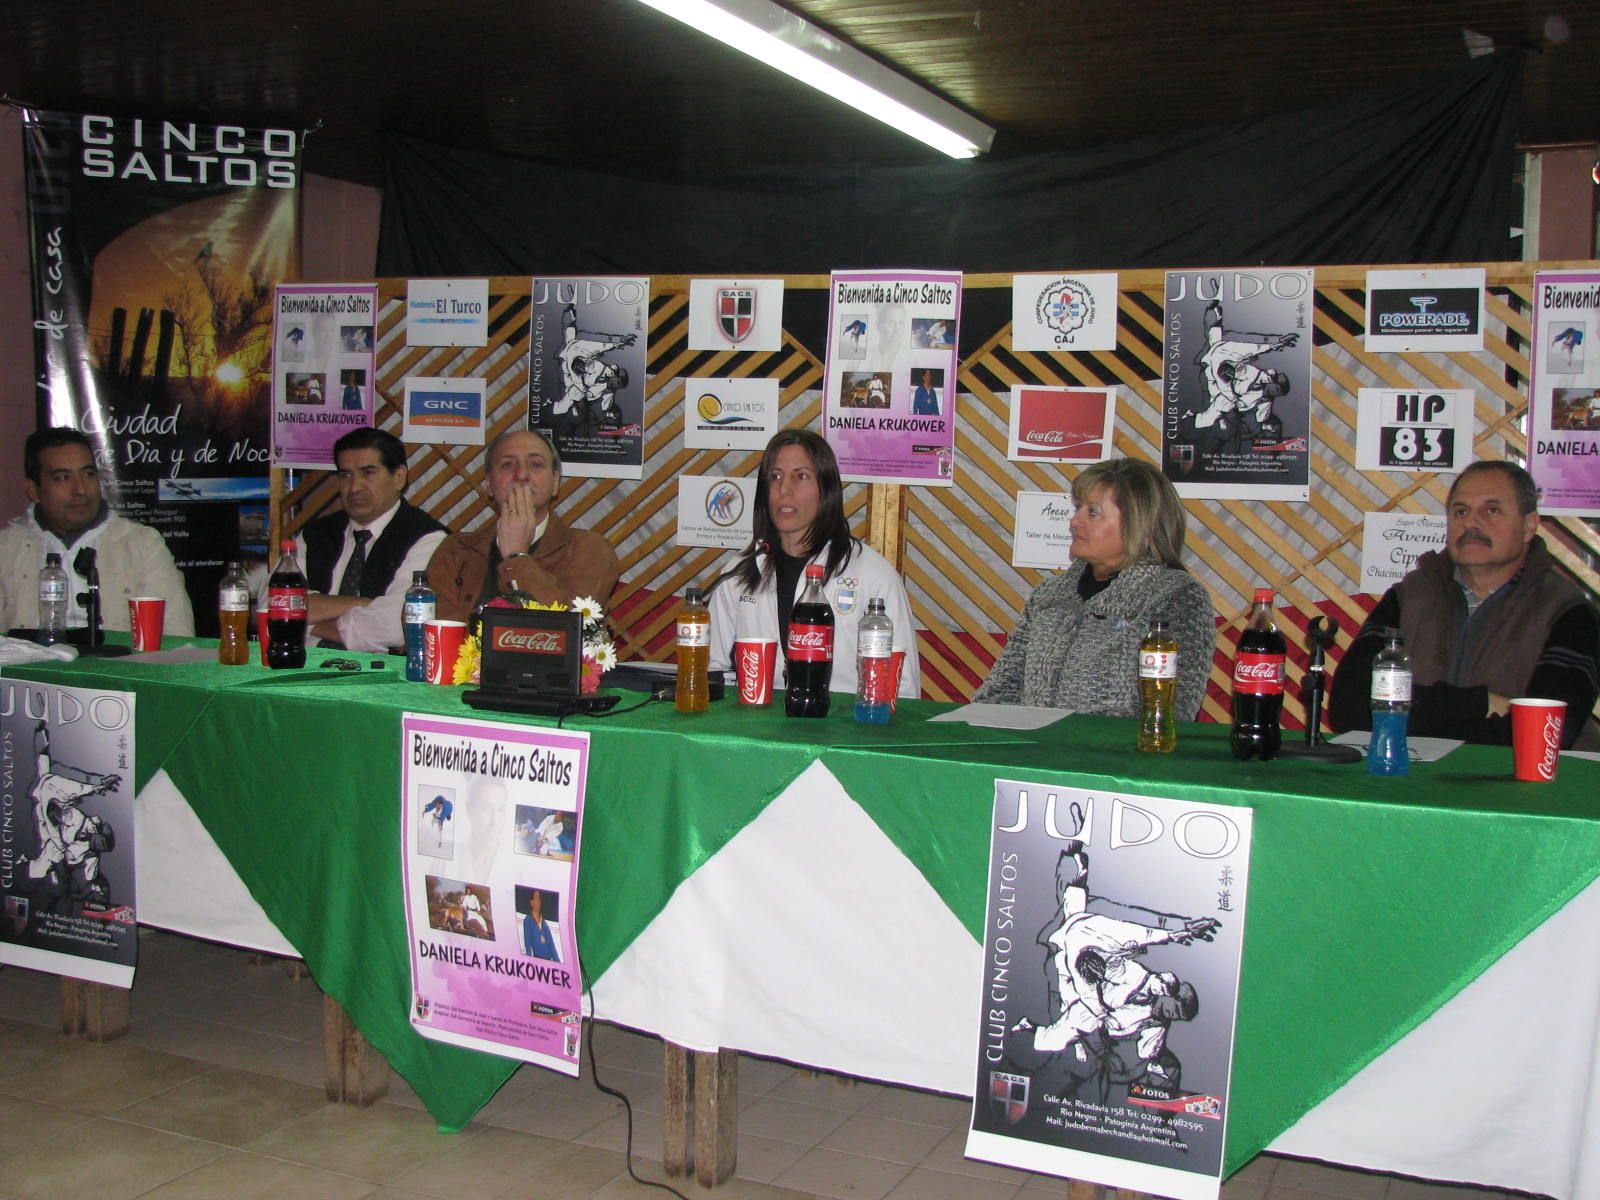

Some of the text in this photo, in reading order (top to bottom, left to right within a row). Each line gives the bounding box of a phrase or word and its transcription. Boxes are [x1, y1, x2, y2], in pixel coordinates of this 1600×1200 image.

[82, 114, 296, 157] CINCO
[82, 149, 296, 189] SALTOS
[46, 227, 63, 295] casa
[535, 280, 645, 305] JUDO
[838, 283, 952, 305] Bienvenida a Cinco Saltos
[1168, 272, 1308, 302] JUDO
[1544, 285, 1600, 309] Bienvenid
[281, 295, 319, 313] Bienvenida
[326, 296, 346, 313] Cinco
[347, 297, 370, 313] Saltos
[436, 299, 447, 313] El
[451, 299, 482, 314] Turco
[1380, 313, 1465, 327] POWERADE
[1054, 335, 1075, 343] CAJ
[531, 313, 545, 424] CLUB CINCO SALTOS
[1167, 312, 1182, 440] CLUB CINCO SALTOS
[424, 400, 469, 411] GNC
[1396, 394, 1446, 422] HP
[278, 411, 368, 425] DANIELA KRUKOWER
[829, 417, 946, 433] DANIELA KRUKOWER
[1027, 430, 1064, 442] Coca-Cola
[1393, 429, 1443, 461] 83
[1537, 440, 1598, 456] DANIELA
[125, 439, 163, 466] Dia
[172, 447, 185, 479] y
[194, 439, 219, 464] de
[228, 438, 274, 464] Noc
[1053, 533, 1072, 541] Mecan
[1383, 528, 1447, 544] Avenid
[498, 630, 561, 651] Coca-Cola
[787, 631, 825, 647] Coca-Cola
[742, 648, 759, 703] Coca-Cola
[1234, 660, 1277, 678] Coca-Cola
[0, 684, 130, 731] JUDO
[1537, 712, 1562, 780] Coca-Cola
[413, 733, 572, 786] Bienvenida a Cinco Saltos
[2, 731, 13, 888] CLUB CINCO SALTOS
[997, 790, 1240, 859] JUDO
[419, 940, 572, 989] DANIELA KRUKOWER
[986, 852, 1018, 1063] CLUB CINCO SALTOS
[994, 1073, 1025, 1084] CACS
[1043, 1094, 1060, 1104] Calle
[1062, 1098, 1072, 1107] Av.
[1075, 1100, 1109, 1114] Rivadavia
[1110, 1107, 1124, 1117] 158
[1142, 1088, 1170, 1100] FOTOS
[1074, 1110, 1097, 1123] Negro
[1140, 1123, 1176, 1136] Argentina
